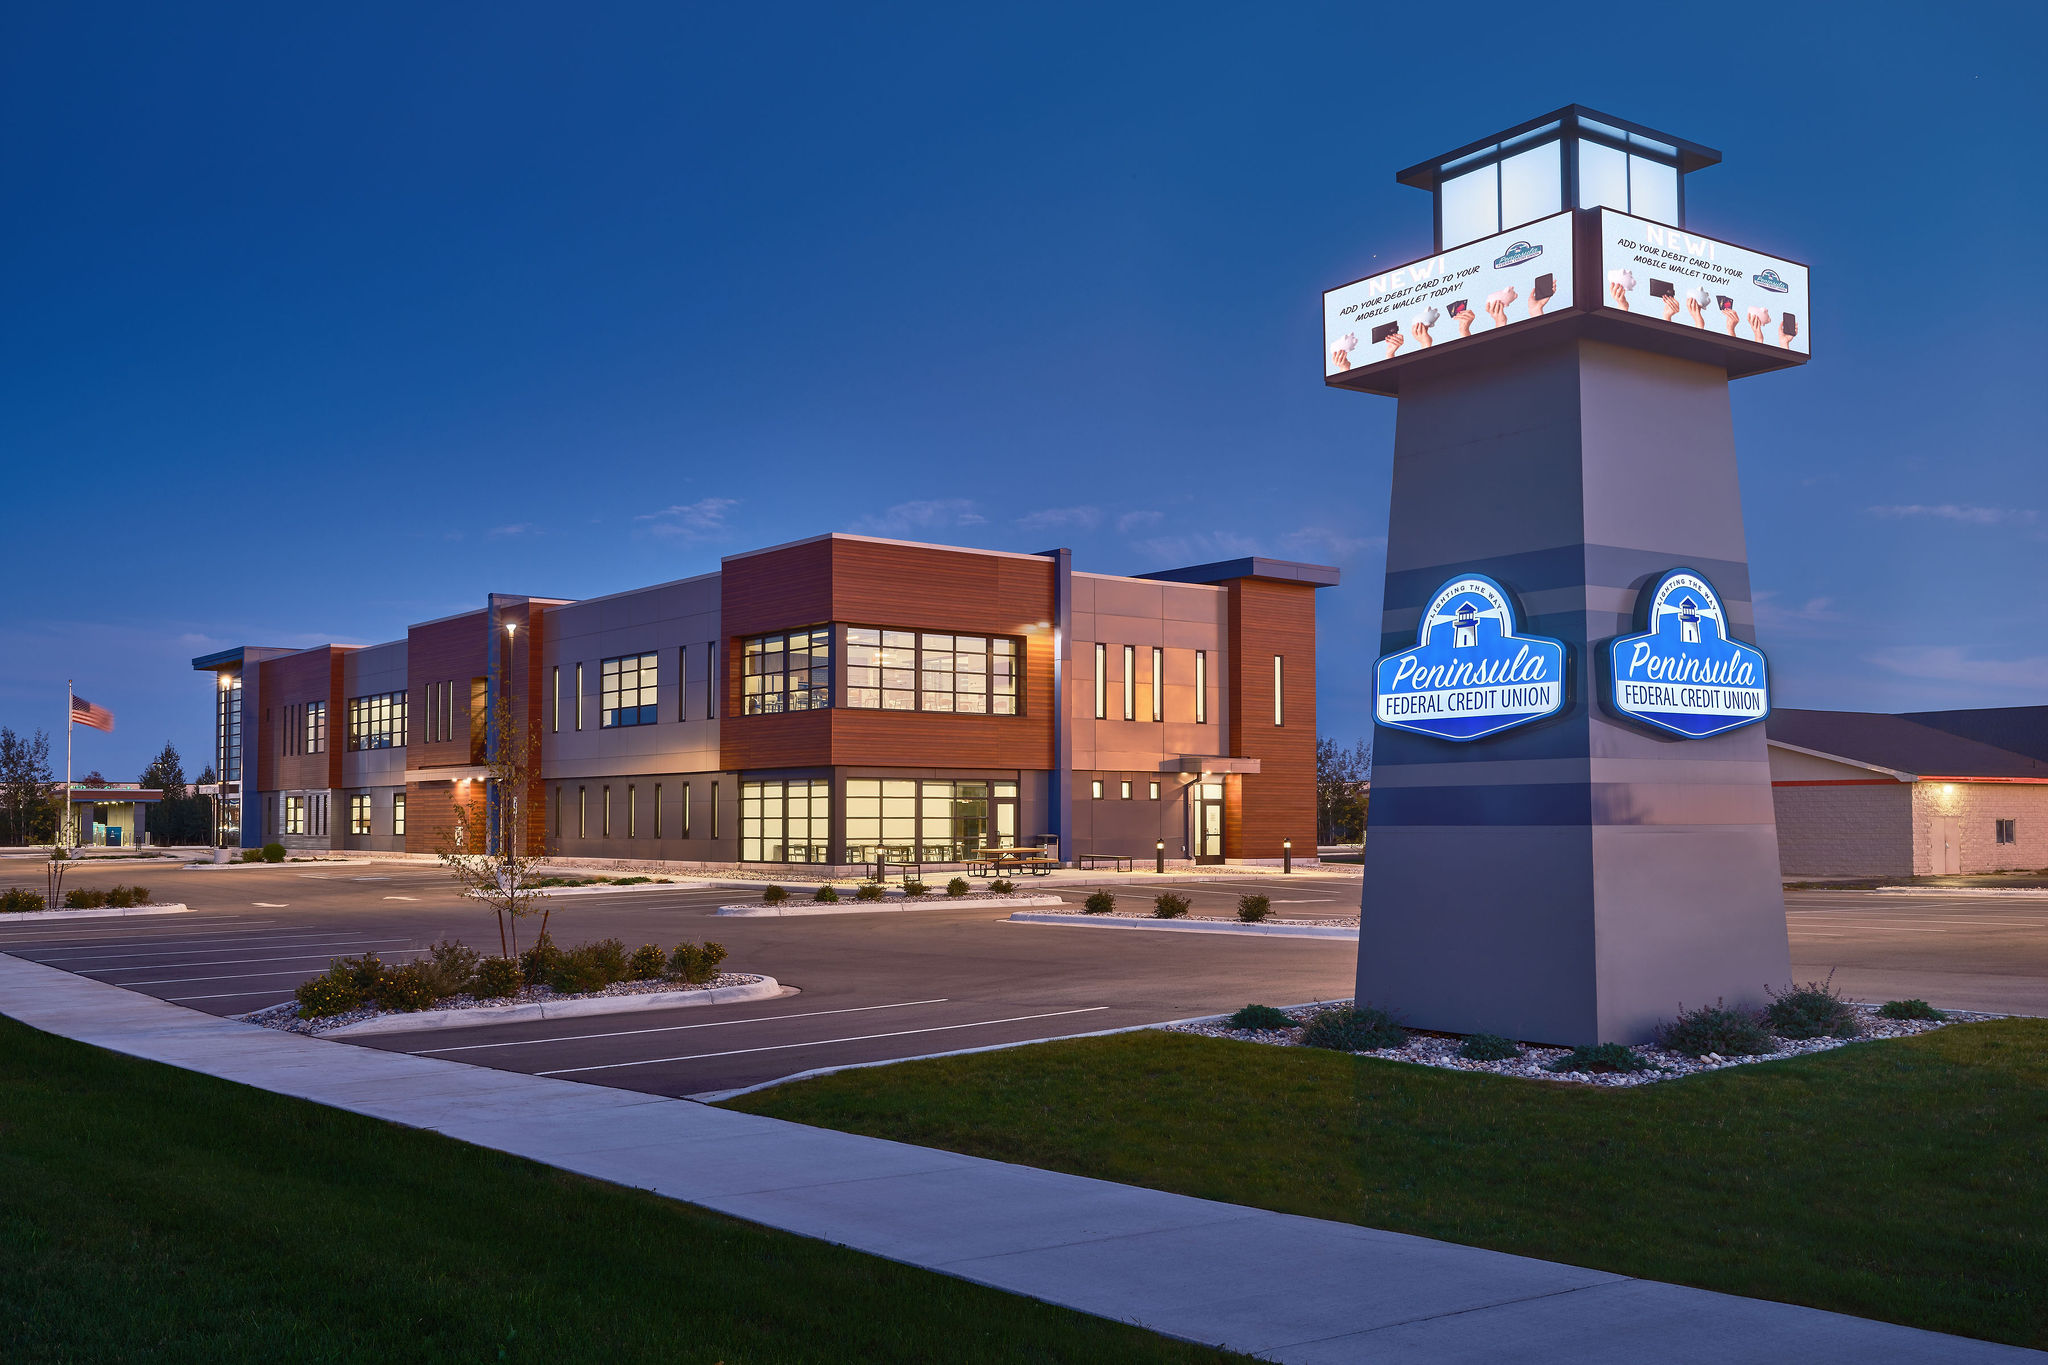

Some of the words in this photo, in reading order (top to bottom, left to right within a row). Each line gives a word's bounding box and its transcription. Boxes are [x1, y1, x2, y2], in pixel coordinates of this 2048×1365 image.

[1617, 238, 1637, 250] ADD
[1639, 243, 1660, 256] YOUR
[1661, 249, 1688, 263] DEBIT
[1689, 257, 1710, 270] CARD
[1712, 263, 1722, 272] TO
[1723, 267, 1743, 279] YOUR
[1633, 254, 1667, 270] MOBILE
[1669, 264, 1701, 278] WALLET
[1702, 271, 1730, 286] TODAY!
[1339, 304, 1359, 317] ADD
[1360, 296, 1383, 310] YOUR
[1384, 287, 1414, 303] DEBIT
[1415, 278, 1440, 293] CARD
[1442, 273, 1454, 284] TO
[1456, 265, 1480, 278] YOUR
[1354, 304, 1390, 322] MOBILE
[1392, 293, 1428, 311] WALLET
[1430, 281, 1464, 299] TODAY!
[1430, 585, 1466, 619] LIGHTING
[1469, 584, 1486, 594] THE
[1488, 591, 1503, 610] WAY
[1657, 578, 1686, 607] LIGHTING
[1688, 579, 1702, 592] THE
[1704, 591, 1717, 611] WAY
[1392, 644, 1547, 691] Peninsula
[1629, 641, 1756, 686] Peninsula
[1386, 694, 1444, 716] FEDERAL
[1447, 689, 1498, 712] CREDIT
[1501, 686, 1551, 708] UNION
[1625, 684, 1678, 707] FEDERAL
[1680, 687, 1721, 709] CREDIT
[1723, 690, 1761, 711] UNION
